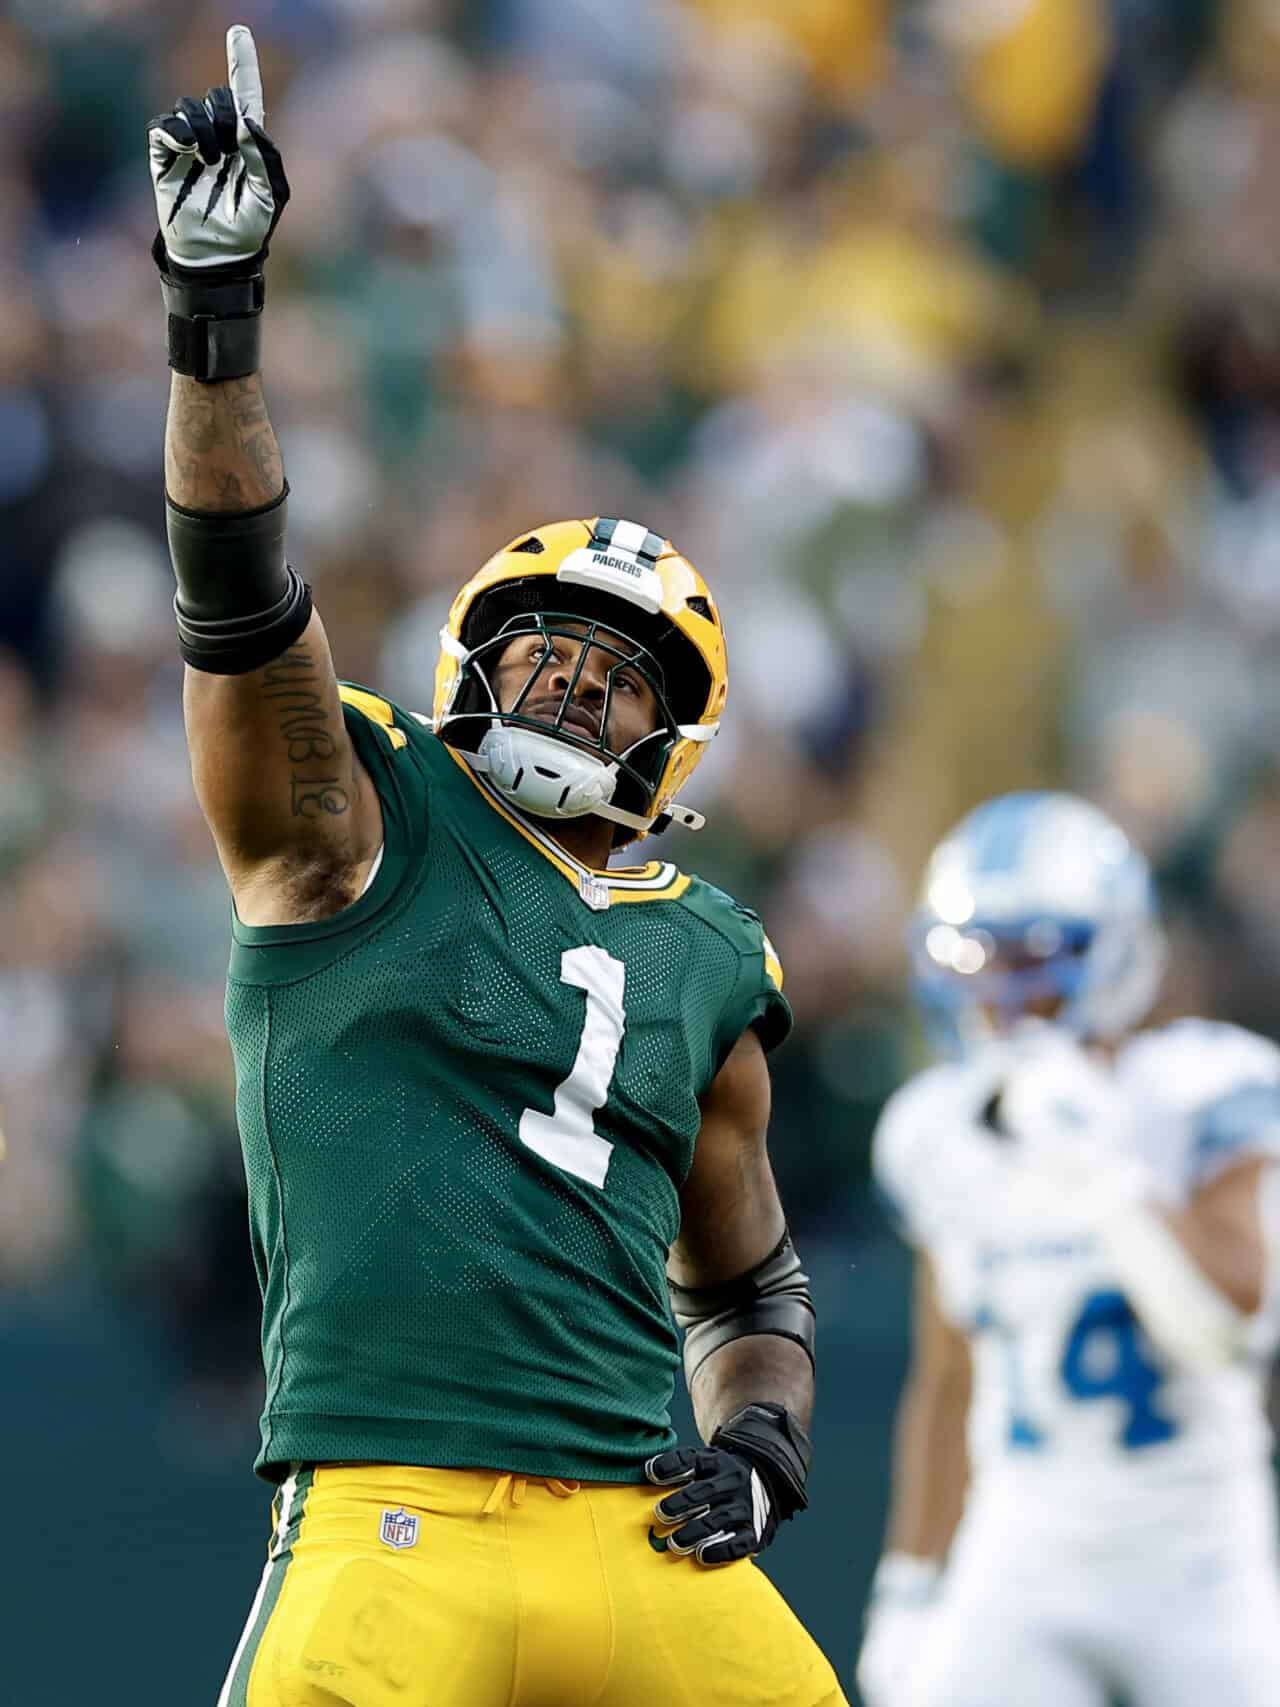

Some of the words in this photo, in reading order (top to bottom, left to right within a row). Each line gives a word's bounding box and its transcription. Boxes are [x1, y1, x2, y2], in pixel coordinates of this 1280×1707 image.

[592, 553, 643, 578] PACKERS
[519, 944, 626, 1189] 1
[387, 1524, 410, 1541] NFL
